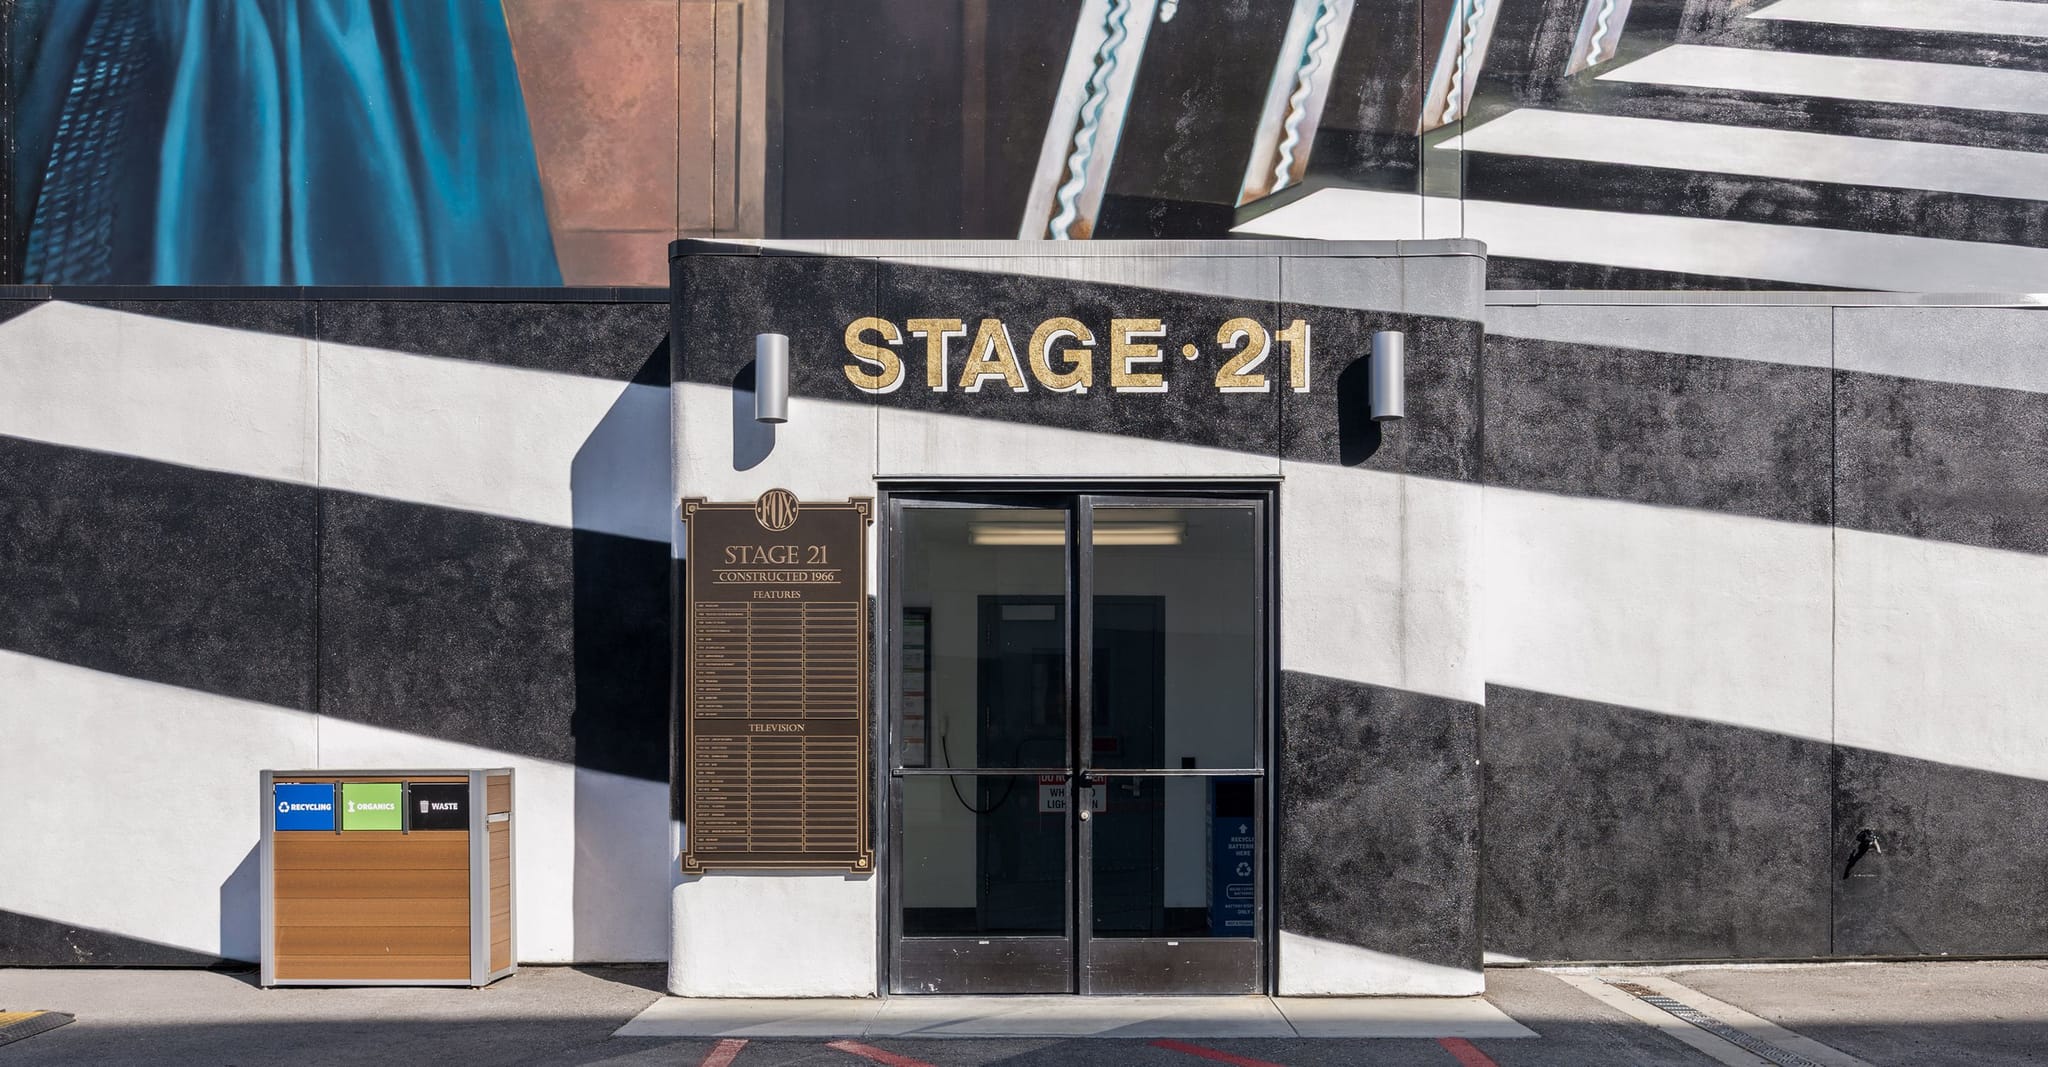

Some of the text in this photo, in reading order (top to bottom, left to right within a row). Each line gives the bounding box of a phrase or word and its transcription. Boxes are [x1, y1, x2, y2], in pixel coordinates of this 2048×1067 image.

[843, 316, 1311, 394] STAGE 21
[761, 490, 793, 529] FOX
[725, 545, 828, 565] STAGE 21
[719, 571, 834, 582] CONSTRUCTED 1966
[753, 590, 801, 599] FEATURES
[748, 723, 805, 732] TELEVISION
[1050, 788, 1065, 797] WH
[290, 803, 332, 812] RECYCLING
[356, 802, 395, 811] ORGANICS
[431, 802, 458, 811] WASTE
[1047, 800, 1066, 809] LIGH
